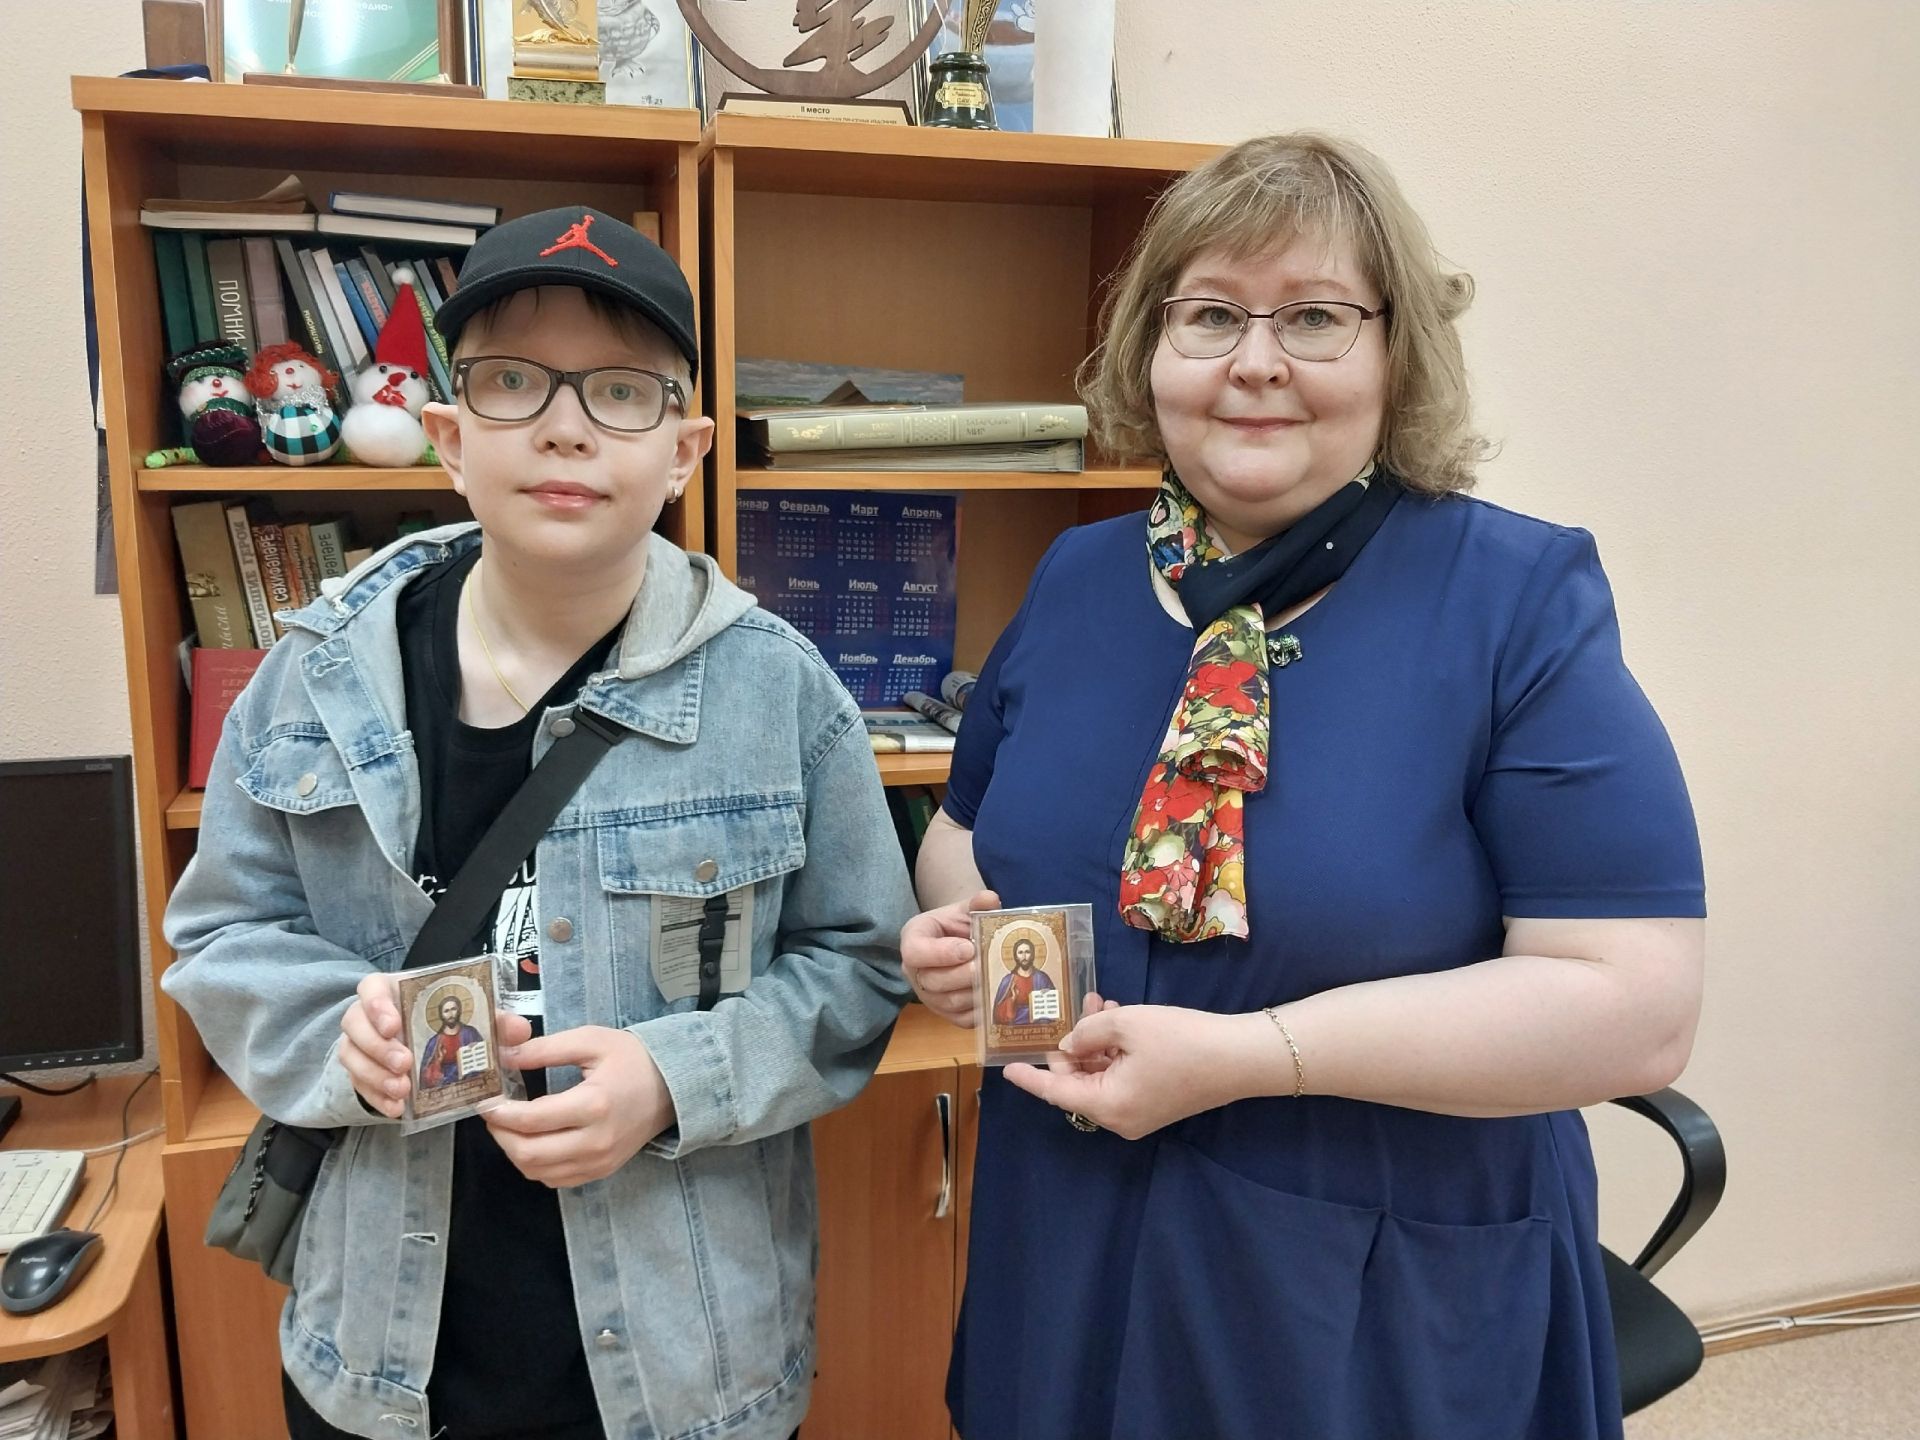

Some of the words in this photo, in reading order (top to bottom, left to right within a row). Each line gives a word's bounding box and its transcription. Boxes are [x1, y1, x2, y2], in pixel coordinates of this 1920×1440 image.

[806, 106, 831, 114] место
[779, 500, 830, 514] Февраль
[850, 504, 879, 516] Март
[902, 506, 943, 519] Апрель
[319, 533, 340, 579] РӘЛӘРЕ
[788, 578, 820, 590] Июнь
[848, 579, 879, 592] Июль
[902, 581, 938, 594] Август
[245, 567, 274, 649] ПОГИБШИЕ
[839, 653, 879, 665] Ноябрь
[892, 654, 938, 666] Декабрь
